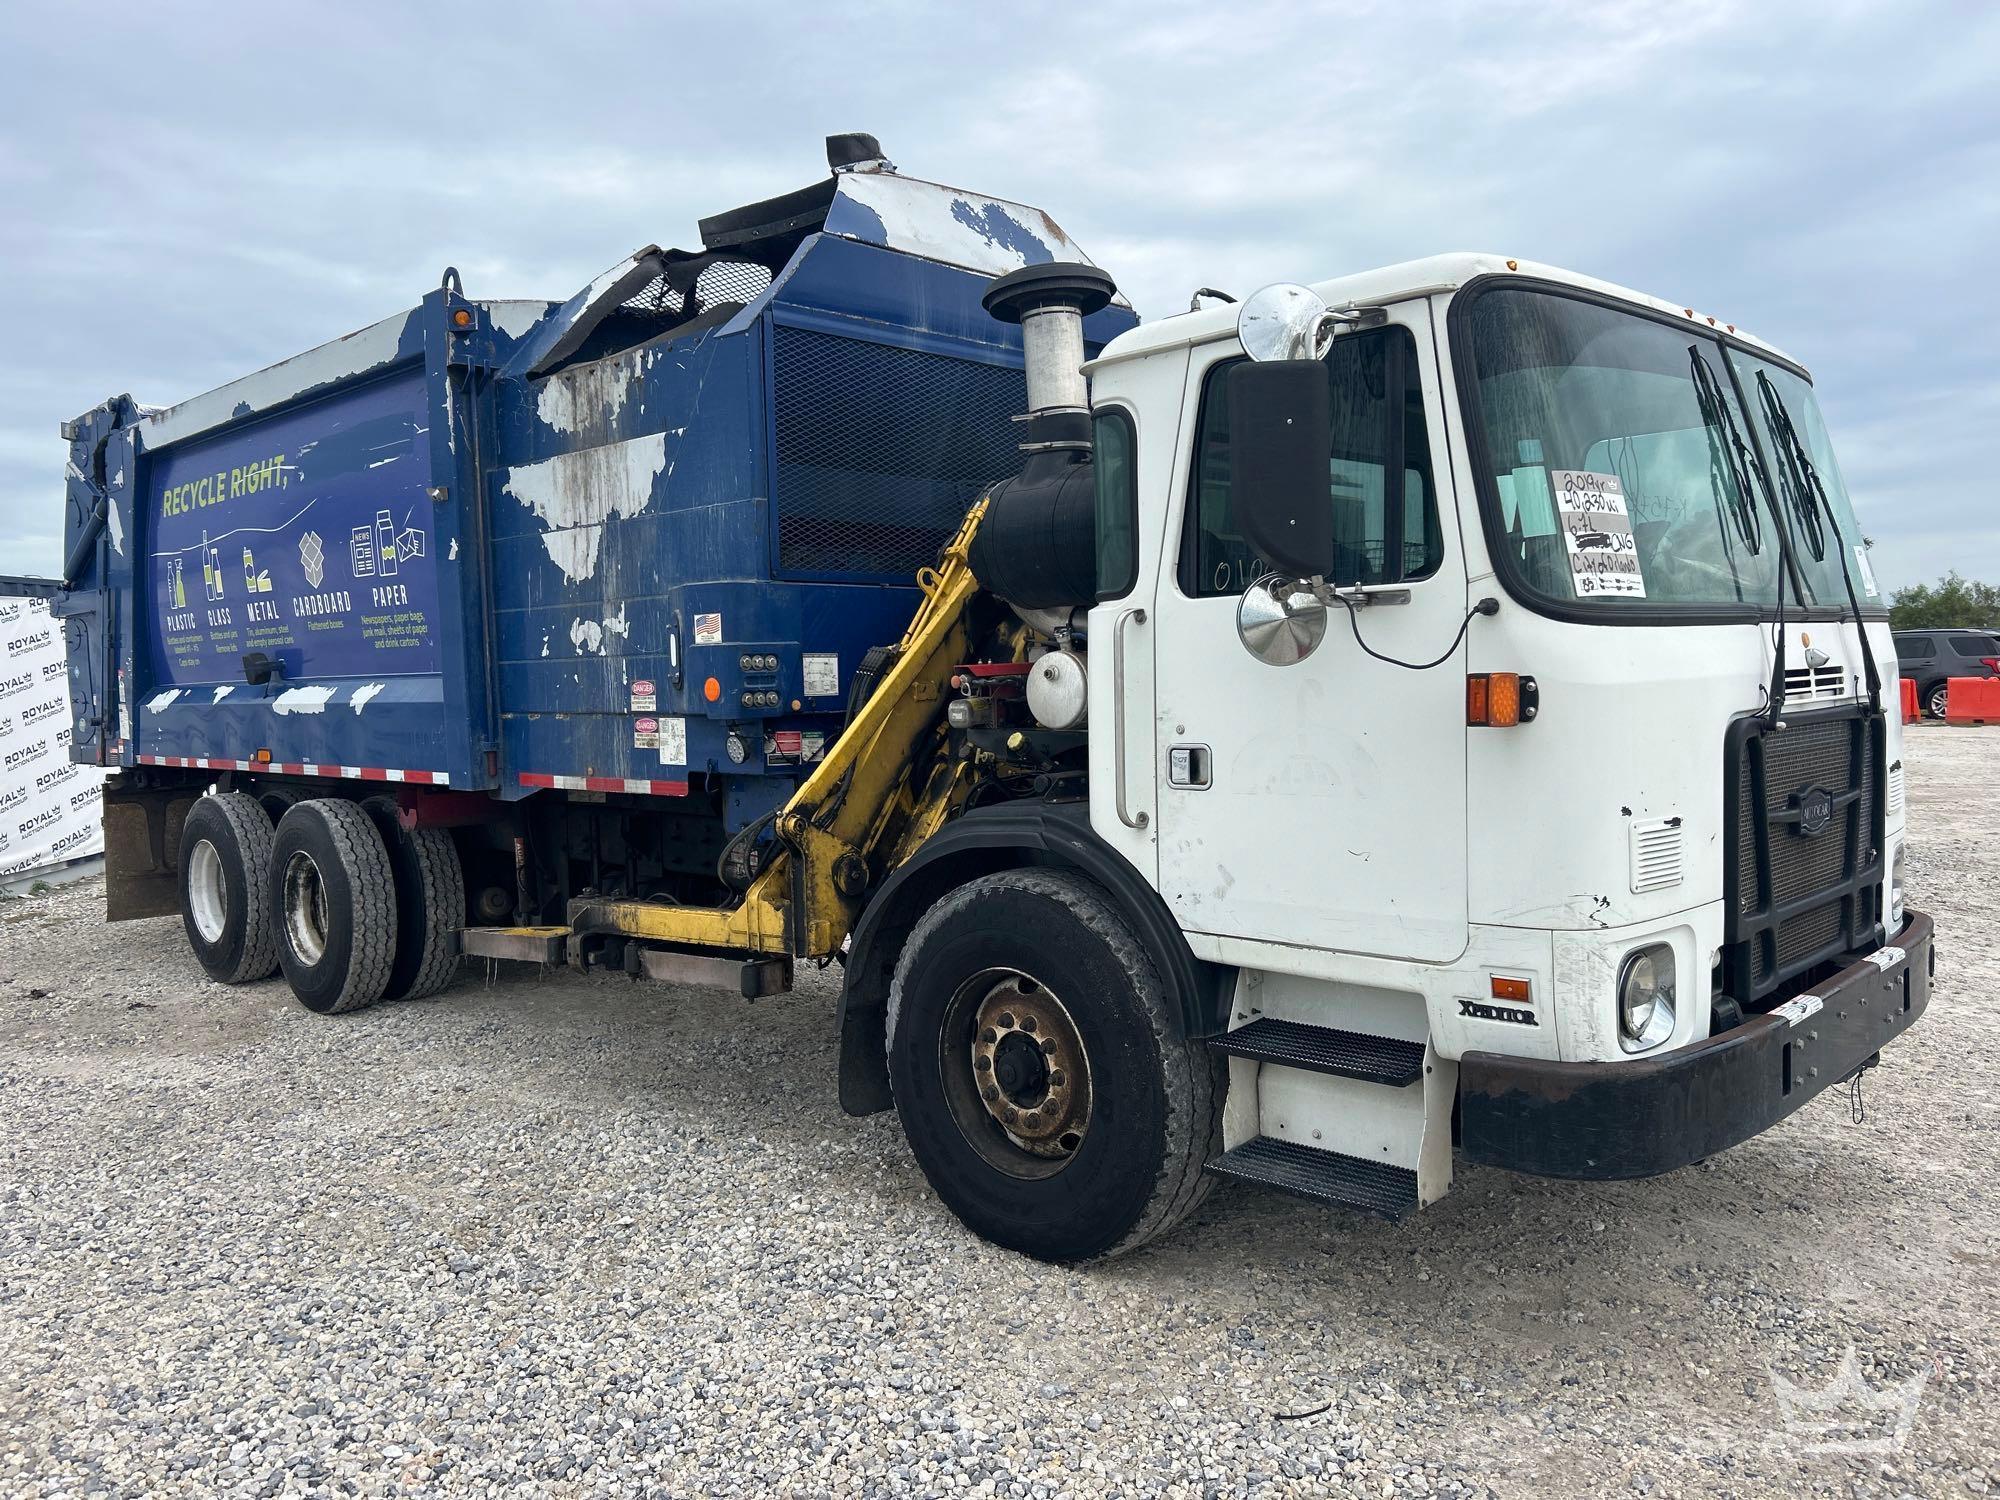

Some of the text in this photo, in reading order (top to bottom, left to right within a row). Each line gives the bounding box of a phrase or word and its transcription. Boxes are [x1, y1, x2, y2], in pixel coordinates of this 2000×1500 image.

[163, 454, 288, 518] RECYCLE RIGHT,
[354, 531, 370, 541] NEWS
[293, 590, 351, 617] CARDBOARD
[372, 584, 408, 607] PAPER
[207, 607, 232, 626] GLASS
[247, 600, 280, 622] METAL
[167, 612, 196, 632] PLASTIC
[8, 634, 41, 651] ROYAL
[10, 641, 52, 658] AUCTION GROUP
[16, 682, 34, 694] GROUP
[22, 701, 55, 720] ROYAL
[24, 706, 65, 727] AUCTION GROUP
[5, 745, 38, 765] ROYAL
[7, 750, 48, 772] AUCTION GROUP
[36, 766, 69, 787] ROYAL
[39, 771, 79, 793] AUCTION GROUP
[10, 796, 28, 808] GROUP
[70, 785, 102, 806] ROYAL
[73, 798, 95, 812] AUCTION
[1803, 803, 1829, 819] AUTOCAR
[19, 811, 53, 833] ROYAL
[21, 815, 62, 840] AUCTION GROUP
[51, 830, 84, 852] ROYAL
[53, 843, 77, 859] AUCTION
[1458, 1000, 1539, 1026] XPEDITOR
